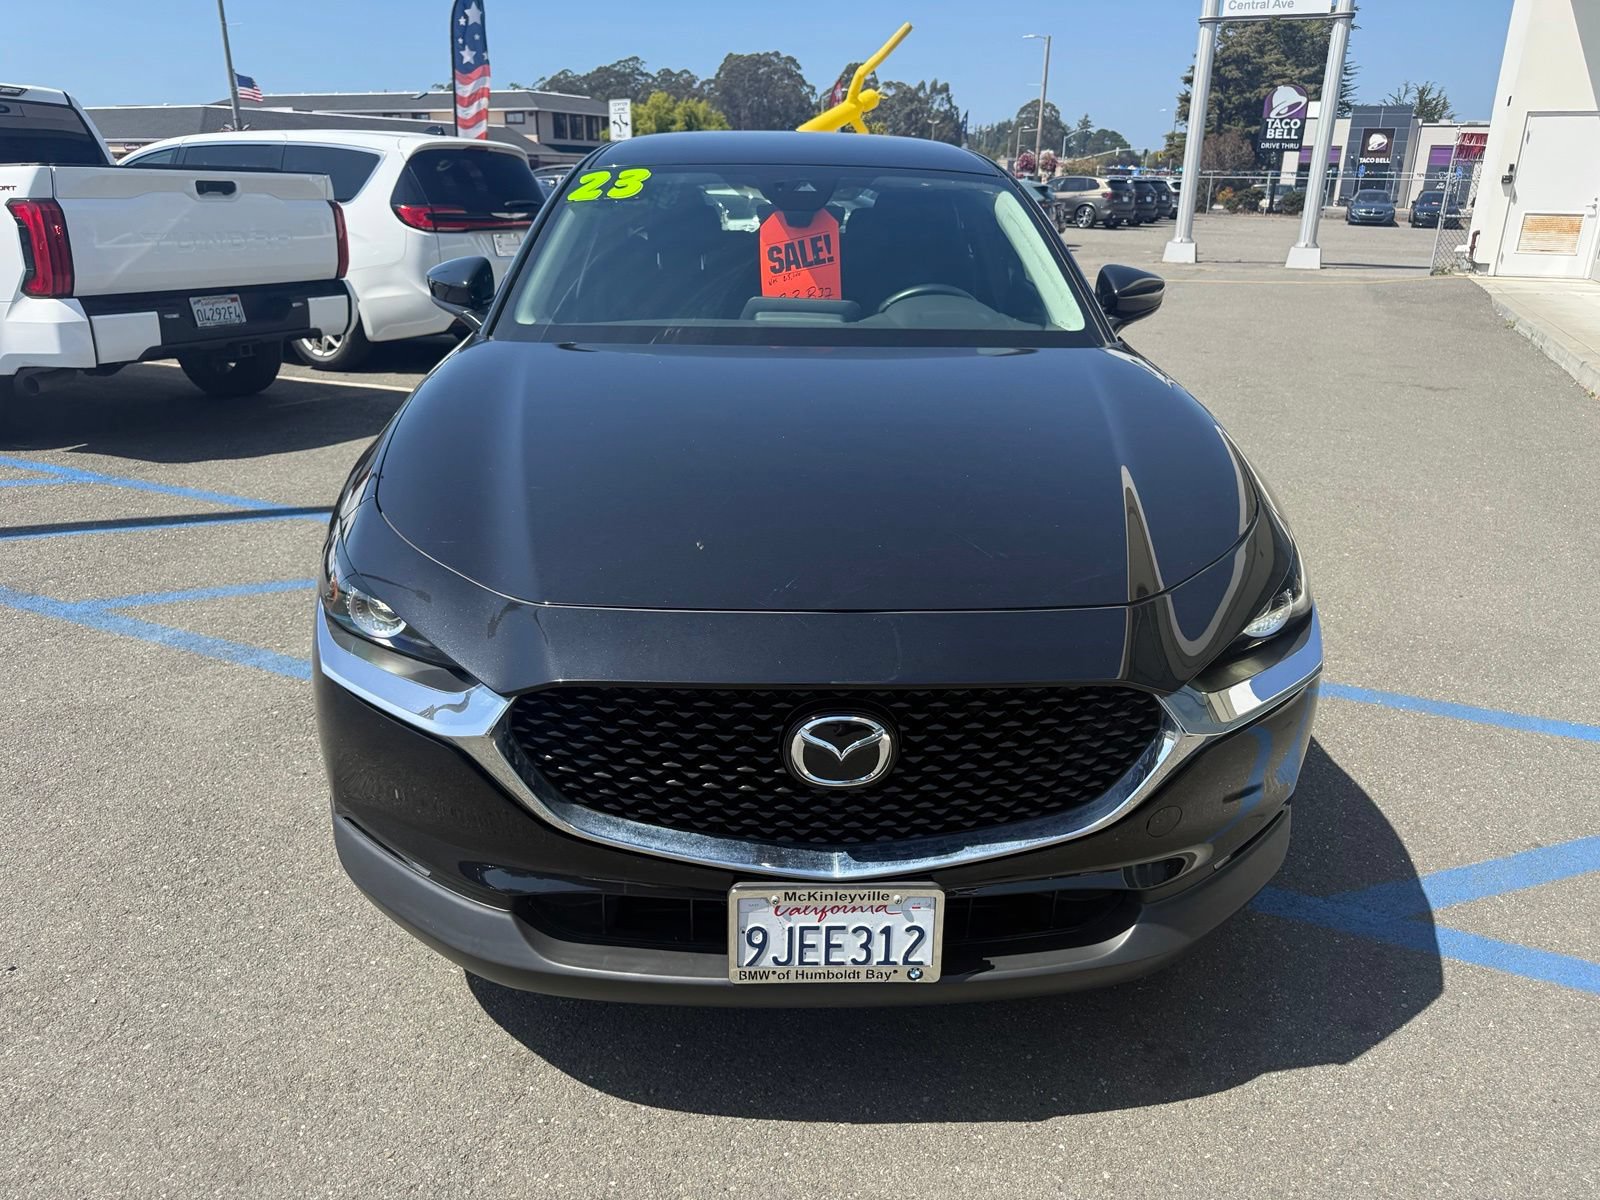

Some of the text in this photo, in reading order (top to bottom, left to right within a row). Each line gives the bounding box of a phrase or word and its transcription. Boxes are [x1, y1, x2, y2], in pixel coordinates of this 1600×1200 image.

[1228, 0, 1295, 10] Central Ave
[1266, 118, 1301, 129] TACO
[1266, 129, 1298, 139] BELL
[567, 168, 652, 202] 23
[767, 234, 834, 275] SALE!
[783, 890, 890, 904] McKinleyville
[773, 903, 902, 923] California
[745, 925, 925, 967] 9JEE312
[738, 969, 893, 983] BMW of Humboldt Bay
